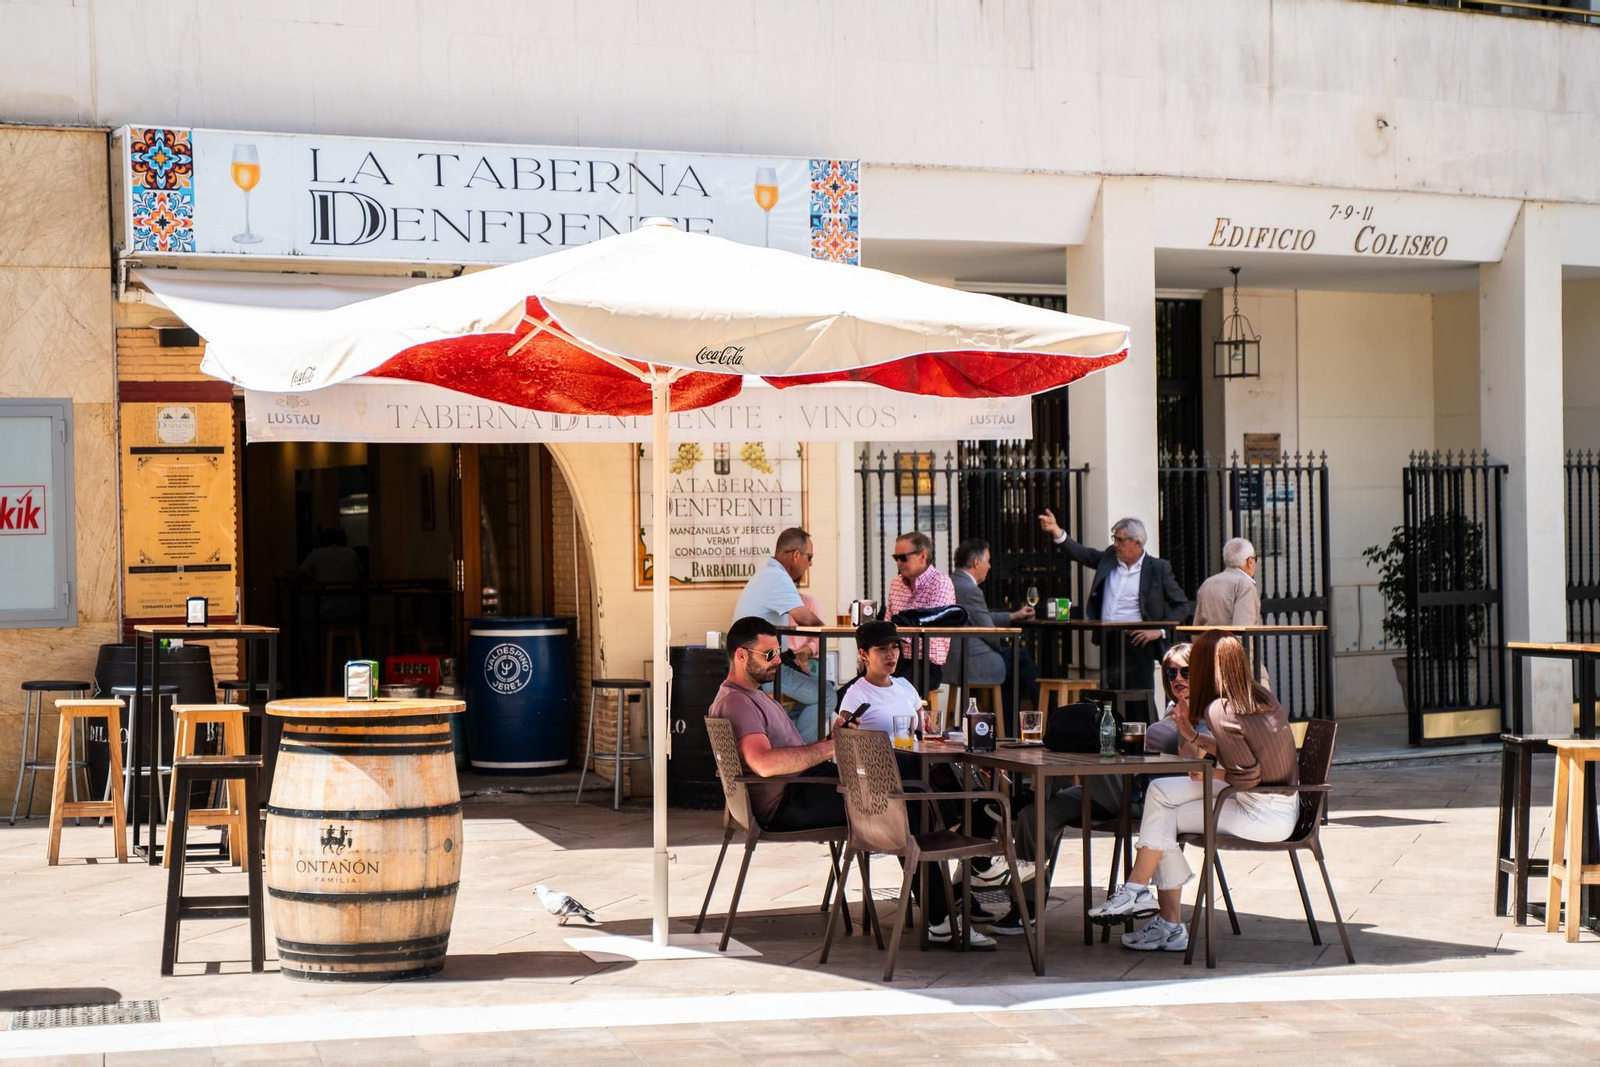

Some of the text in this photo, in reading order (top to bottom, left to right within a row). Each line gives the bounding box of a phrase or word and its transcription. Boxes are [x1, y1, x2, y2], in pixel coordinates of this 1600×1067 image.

[310, 148, 711, 197] LA TABERNA
[267, 412, 321, 425] LUSTAU
[387, 404, 543, 430] TABERNA
[799, 405, 898, 429] VINOS
[970, 414, 1016, 425] LUSTAU
[687, 477, 784, 494] TABERNA
[669, 525, 776, 536] MANZANILLAS Y JERECES
[706, 536, 740, 546] VERMUT
[674, 546, 771, 557] CONDADO DE HUELVA
[691, 561, 756, 578] BARBADILLO
[486, 646, 530, 672] VALDESPINO
[492, 678, 523, 691] JEREZ
[295, 858, 380, 875] ONTAÑÓN
